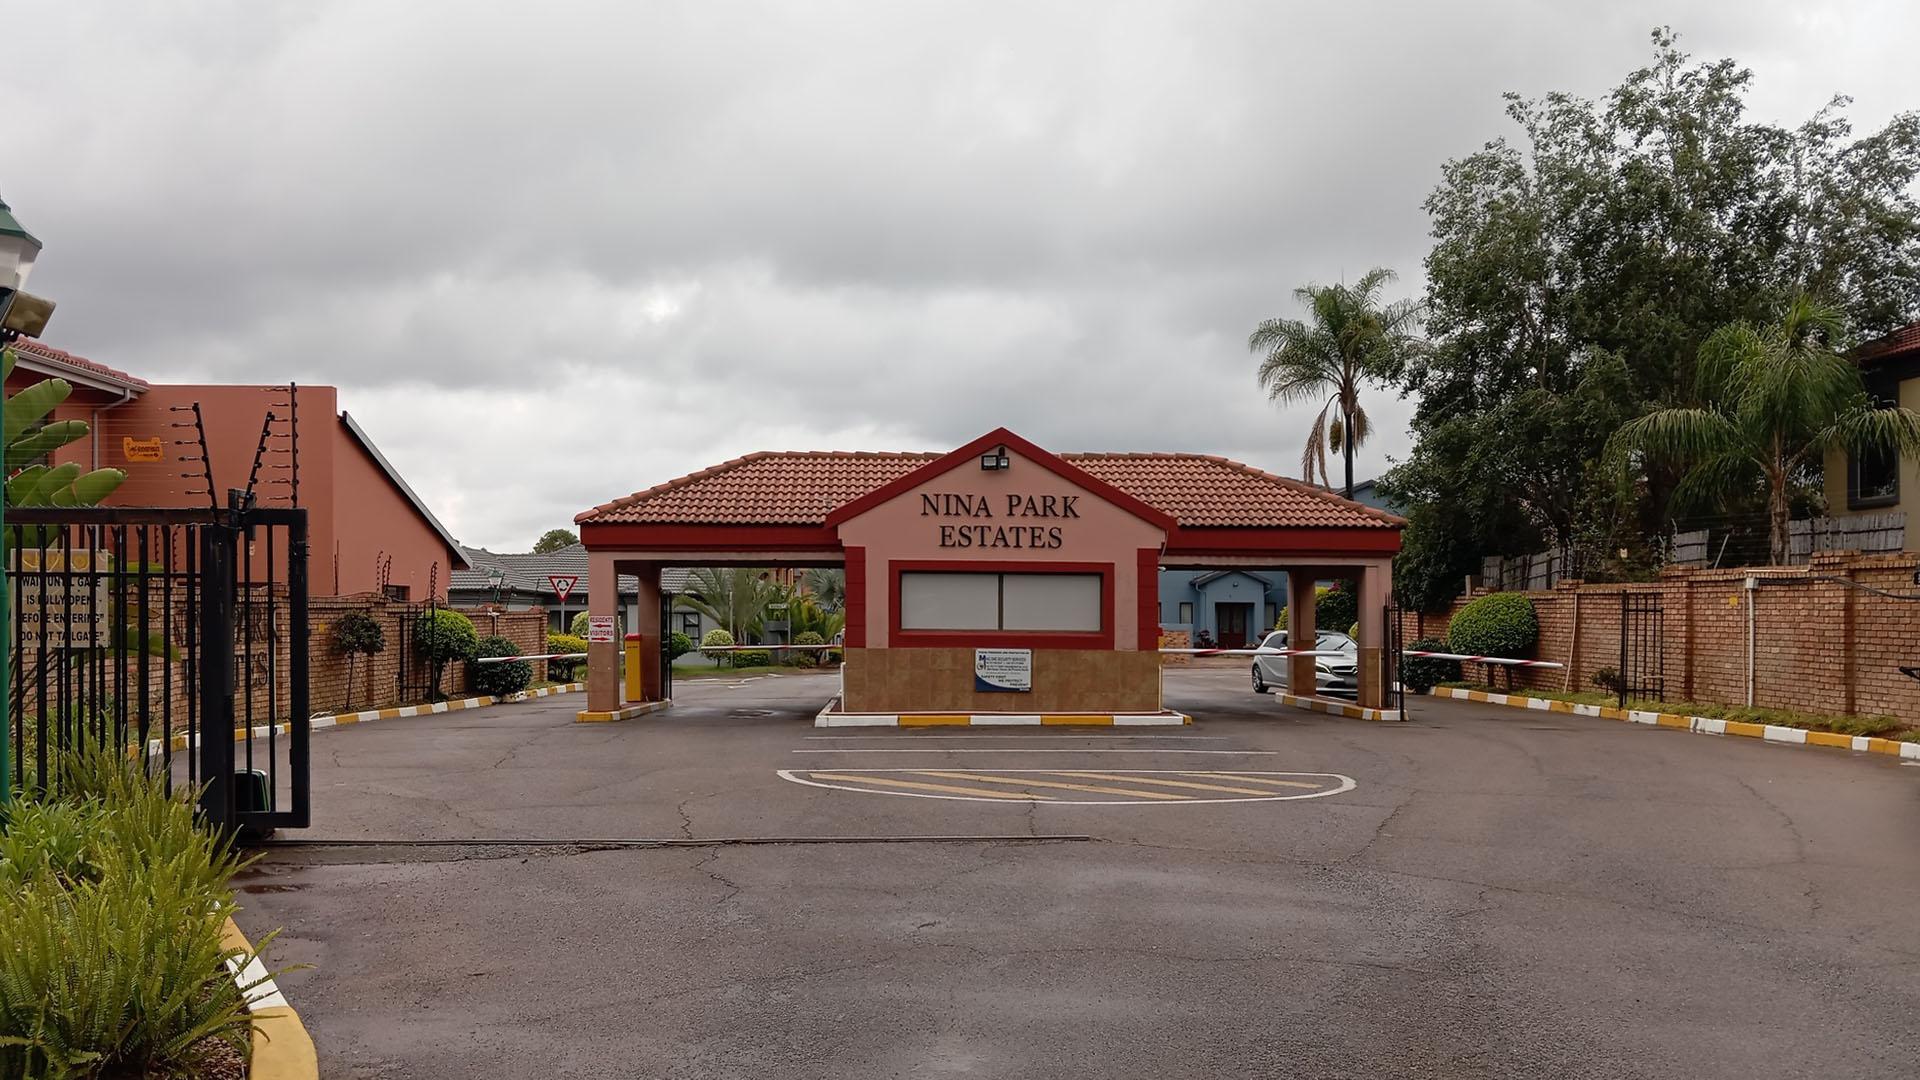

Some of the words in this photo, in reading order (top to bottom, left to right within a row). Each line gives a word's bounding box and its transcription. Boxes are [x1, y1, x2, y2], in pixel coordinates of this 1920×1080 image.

[921, 494, 992, 517] NINA
[1006, 494, 1080, 518] PARK
[939, 525, 1062, 549] ESTATES
[78, 575, 101, 587] GAE
[27, 595, 35, 605] IS
[19, 613, 51, 623] EFOE
[35, 631, 54, 641] NT
